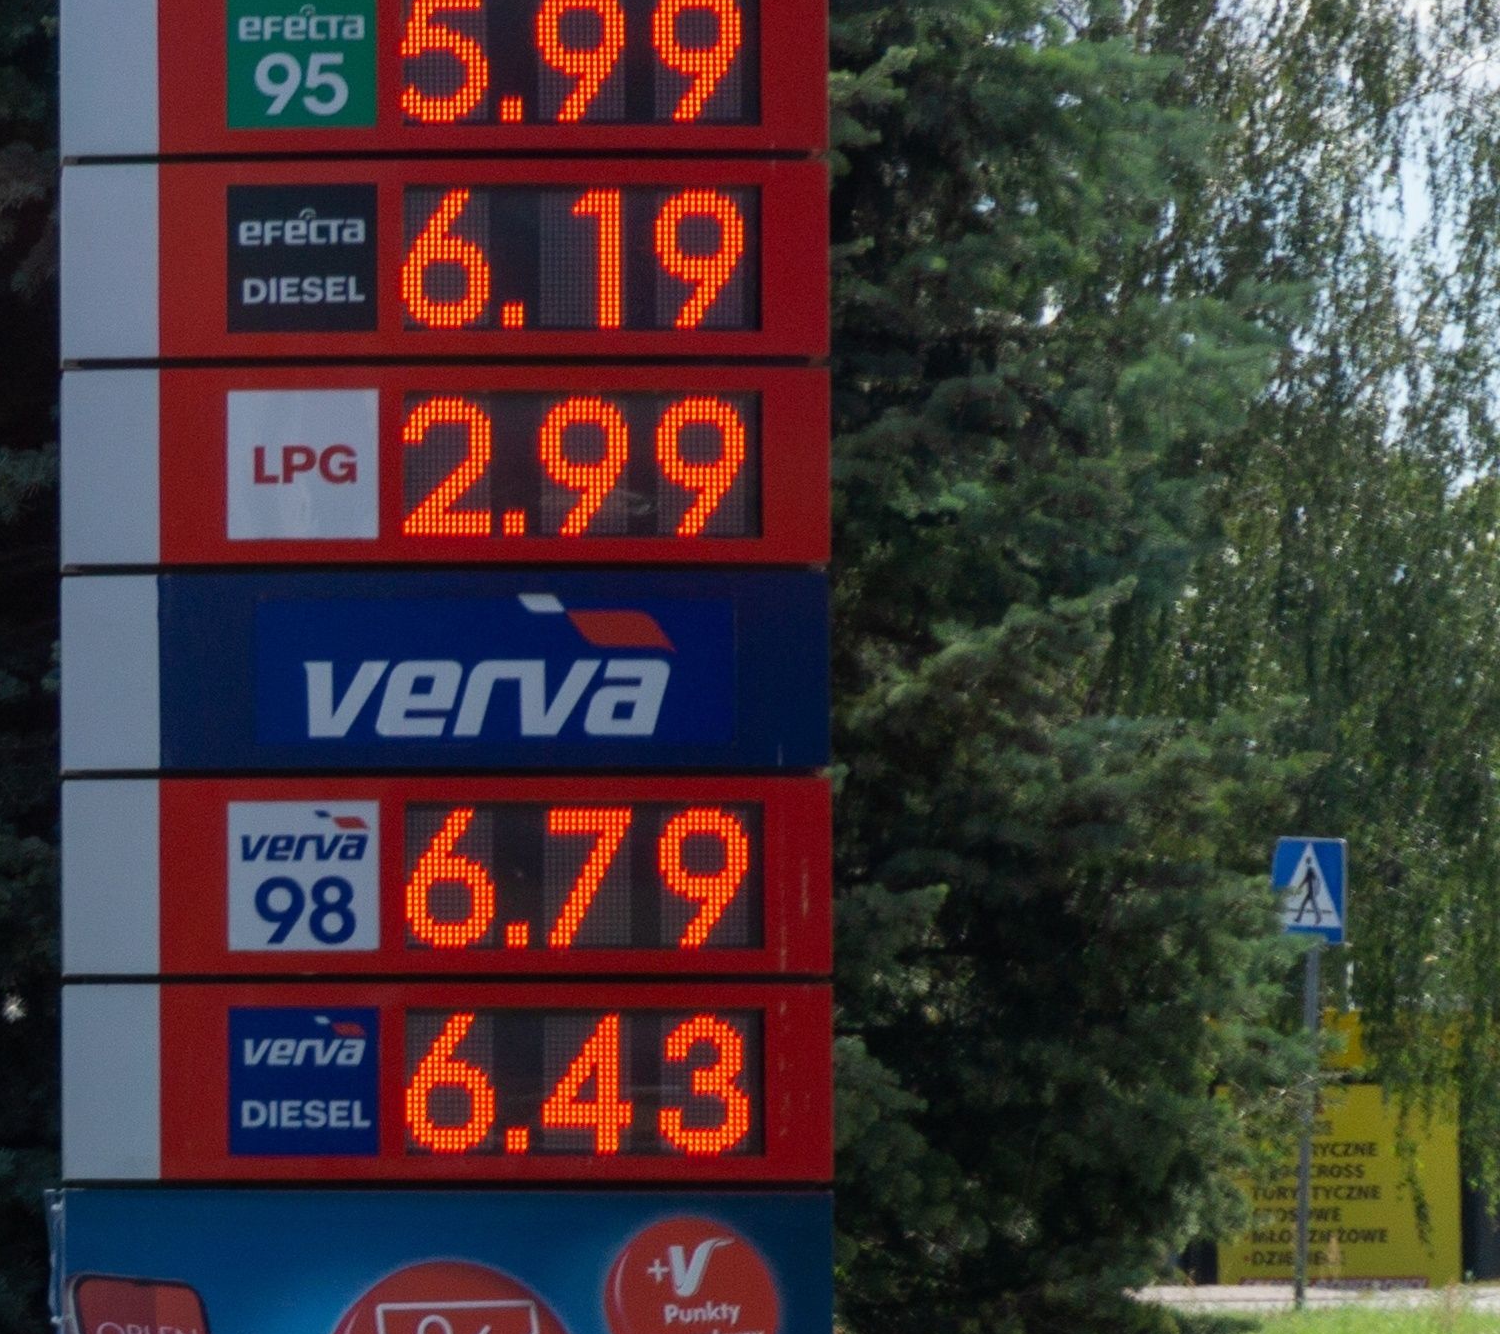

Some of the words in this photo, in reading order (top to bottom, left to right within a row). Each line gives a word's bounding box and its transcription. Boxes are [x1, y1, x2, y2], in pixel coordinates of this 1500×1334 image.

[254, 52, 349, 116] 95
[242, 275, 366, 305] DIESEL
[400, 188, 744, 330] 6.19
[252, 444, 358, 484] LPG
[402, 396, 746, 537] 2.99
[303, 658, 672, 738] verva
[241, 833, 368, 862] verva
[405, 808, 749, 948] 6.79
[254, 876, 357, 946] 98
[243, 1038, 367, 1067] verva
[405, 1013, 750, 1154] 6.43
[241, 1100, 371, 1128] DIESEL
[664, 1301, 741, 1325] Punkty
